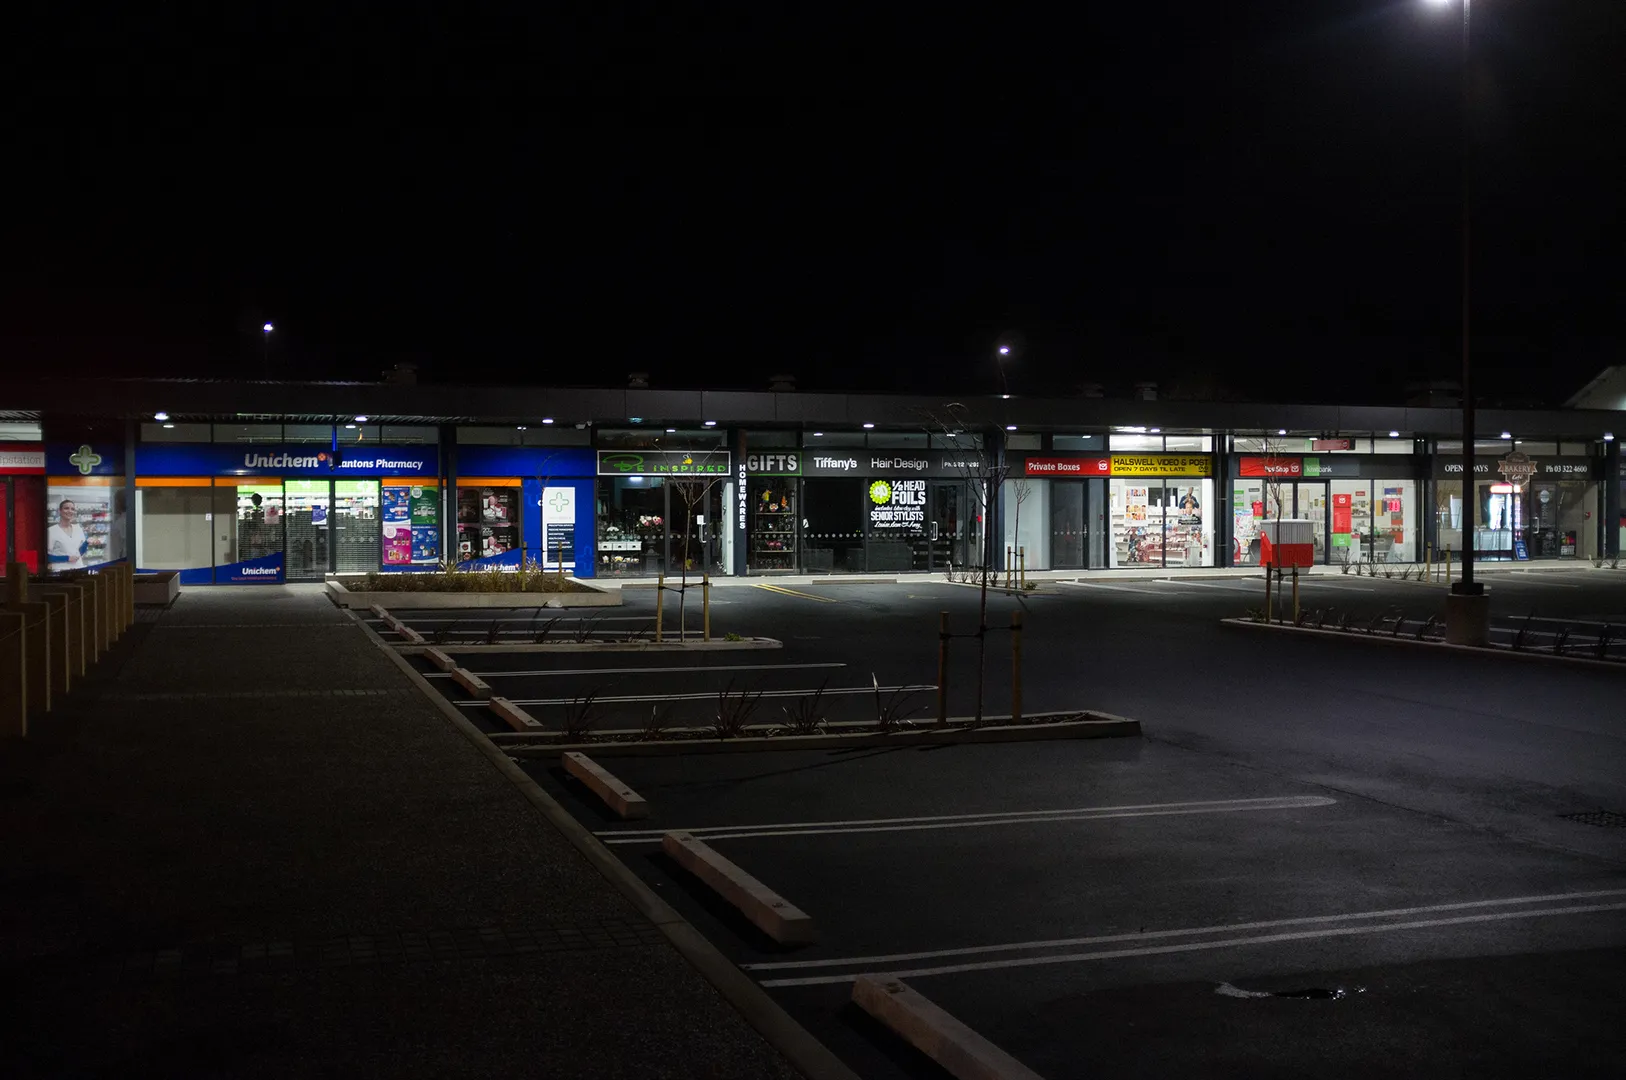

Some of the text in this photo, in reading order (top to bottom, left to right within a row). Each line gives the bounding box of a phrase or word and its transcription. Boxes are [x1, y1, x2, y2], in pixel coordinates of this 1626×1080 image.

[244, 452, 318, 468] Unichem
[338, 459, 423, 470] antons Pharmacy
[747, 454, 798, 471] GIFTS
[813, 457, 929, 470] Tiffany's Hair Design
[1113, 458, 1209, 466] HALSWELL VIDEO & POST
[1028, 462, 1081, 471] Private Boxes
[1444, 464, 1489, 473] OPEN AYS
[1504, 464, 1531, 473] BAKERY
[1545, 465, 1588, 473] Ph 03 322 4600
[903, 480, 926, 491] HEAD
[738, 464, 747, 530] HOMEWARES
[891, 491, 926, 505] FOILS
[870, 511, 924, 521] SENIOR STYLISTS
[241, 566, 277, 575] Unichem
